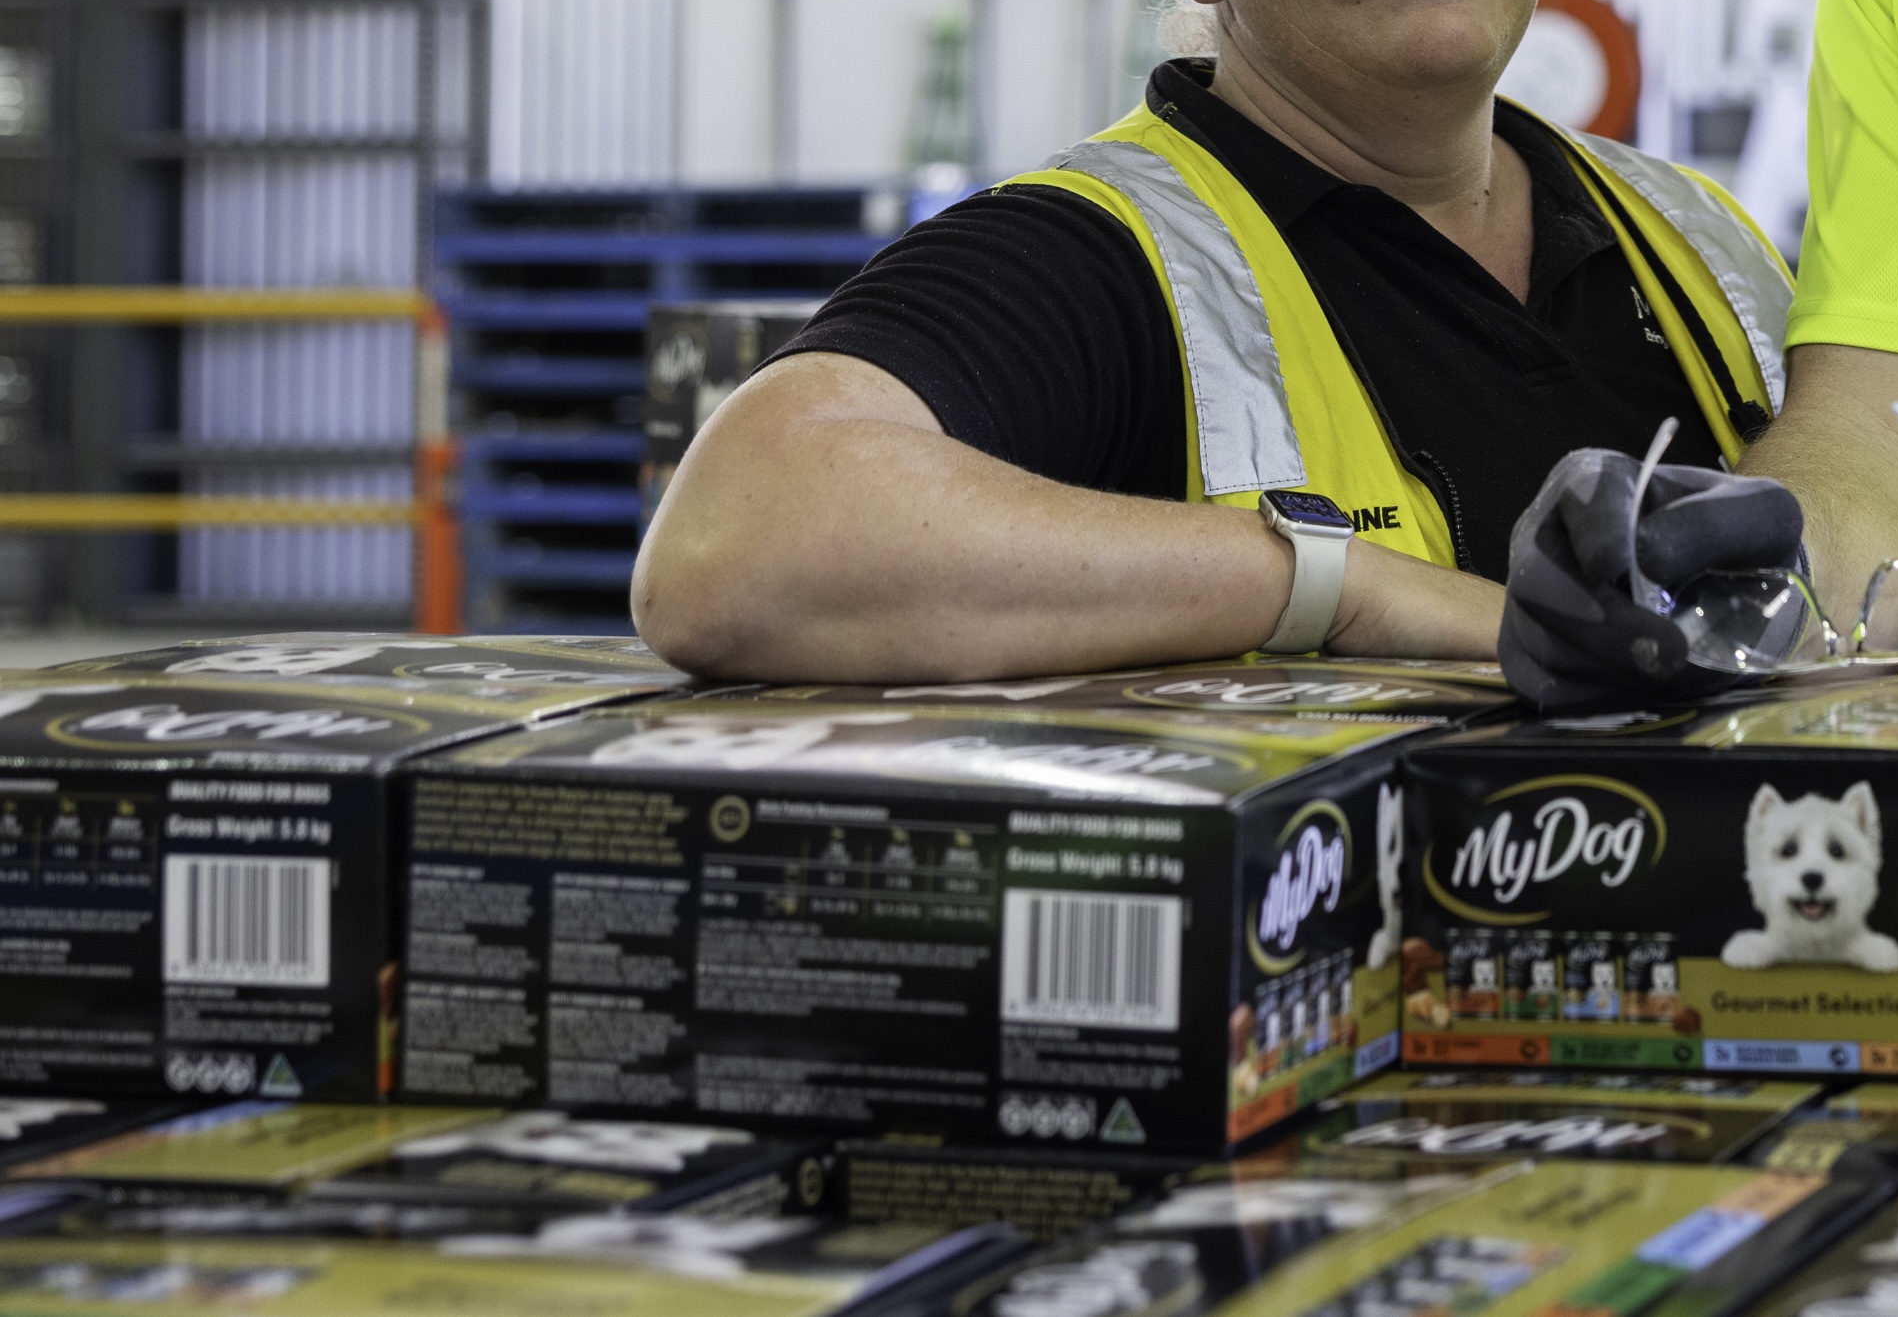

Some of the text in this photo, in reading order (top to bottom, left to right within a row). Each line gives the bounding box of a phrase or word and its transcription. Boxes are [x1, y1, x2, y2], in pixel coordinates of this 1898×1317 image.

[1260, 825, 1344, 950] MyDog
[1451, 796, 1645, 904] MyDog
[1711, 989, 1810, 1015] Gourmet
